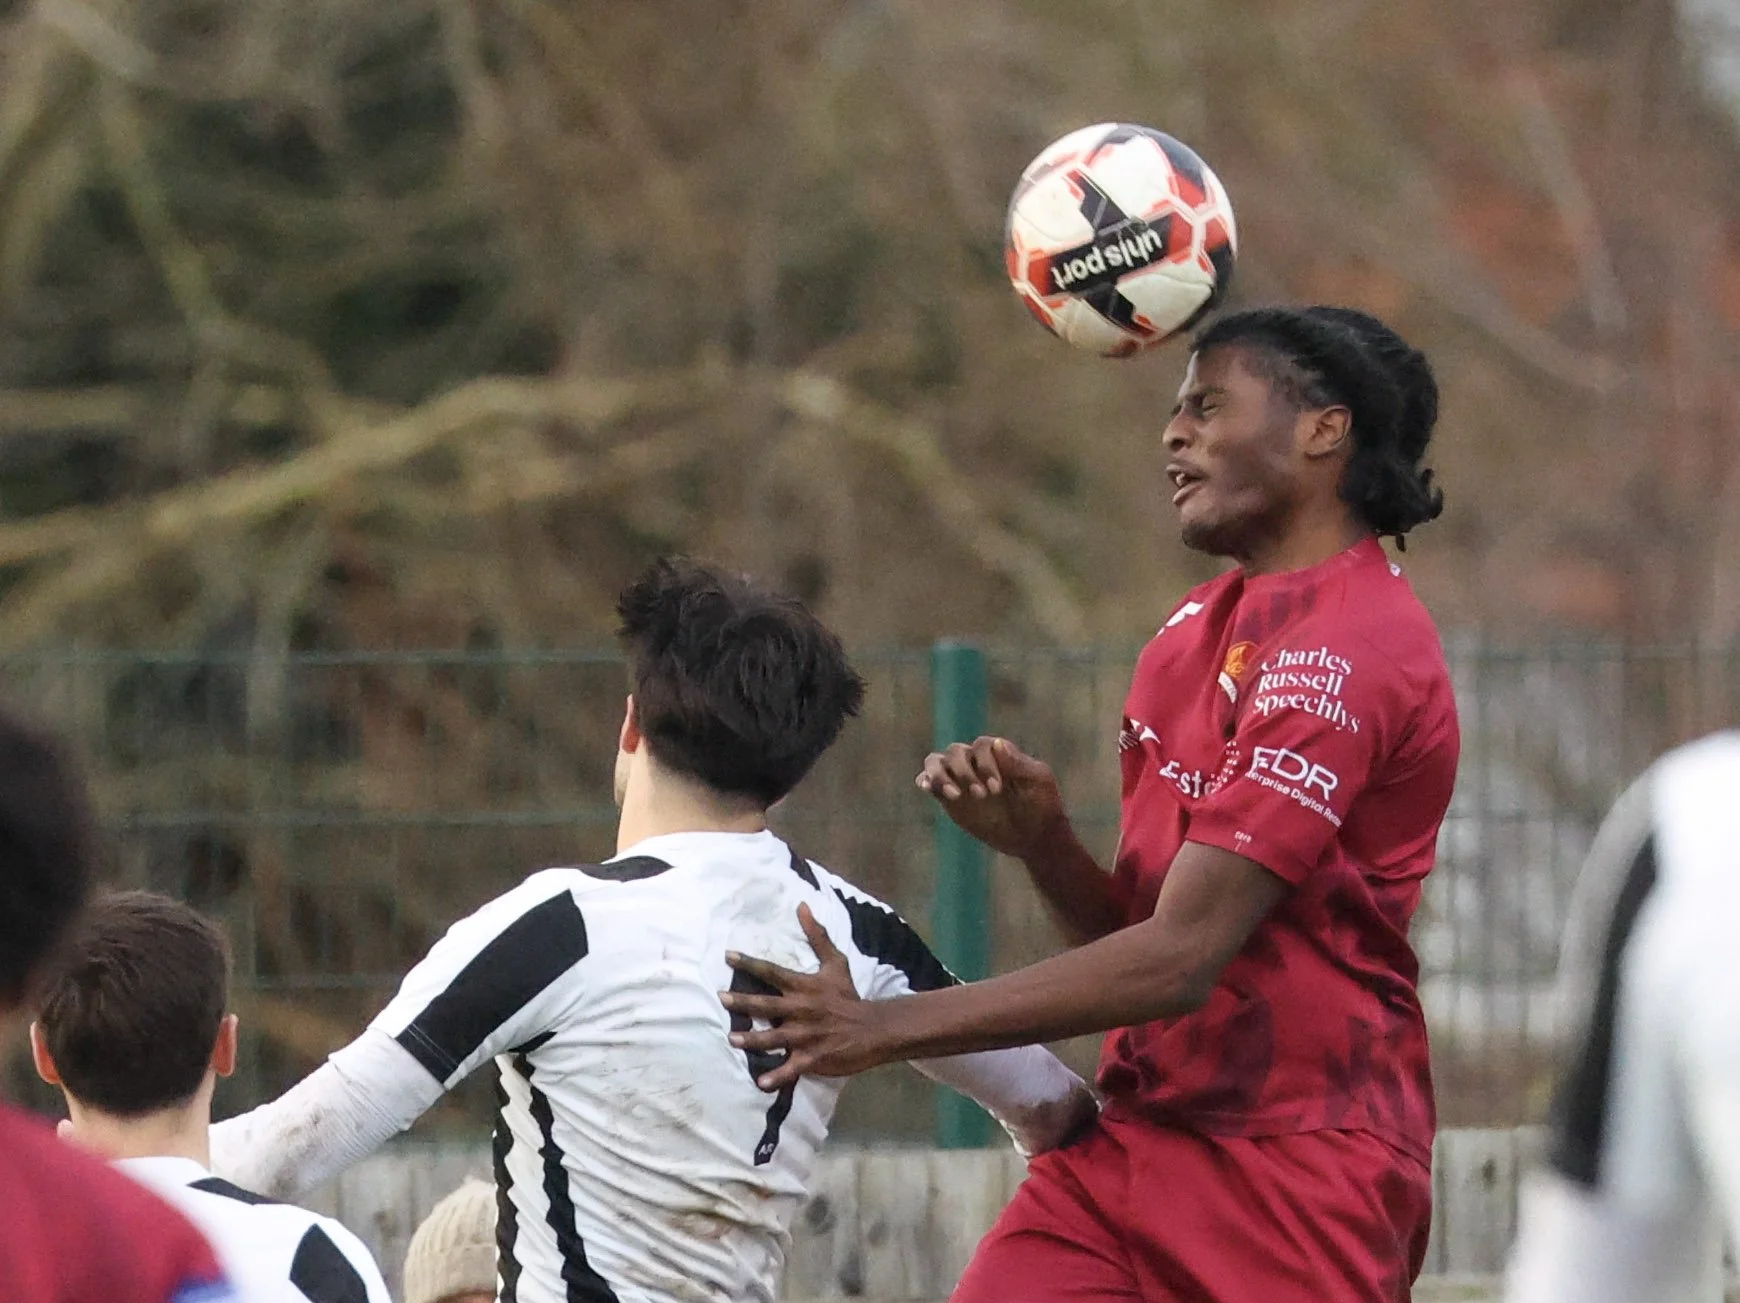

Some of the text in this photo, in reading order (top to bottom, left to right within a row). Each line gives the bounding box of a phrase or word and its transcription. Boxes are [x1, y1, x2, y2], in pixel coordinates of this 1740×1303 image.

[1051, 228, 1163, 290] uhlsport
[1260, 646, 1353, 676] Charles
[1257, 671, 1344, 697] Russell
